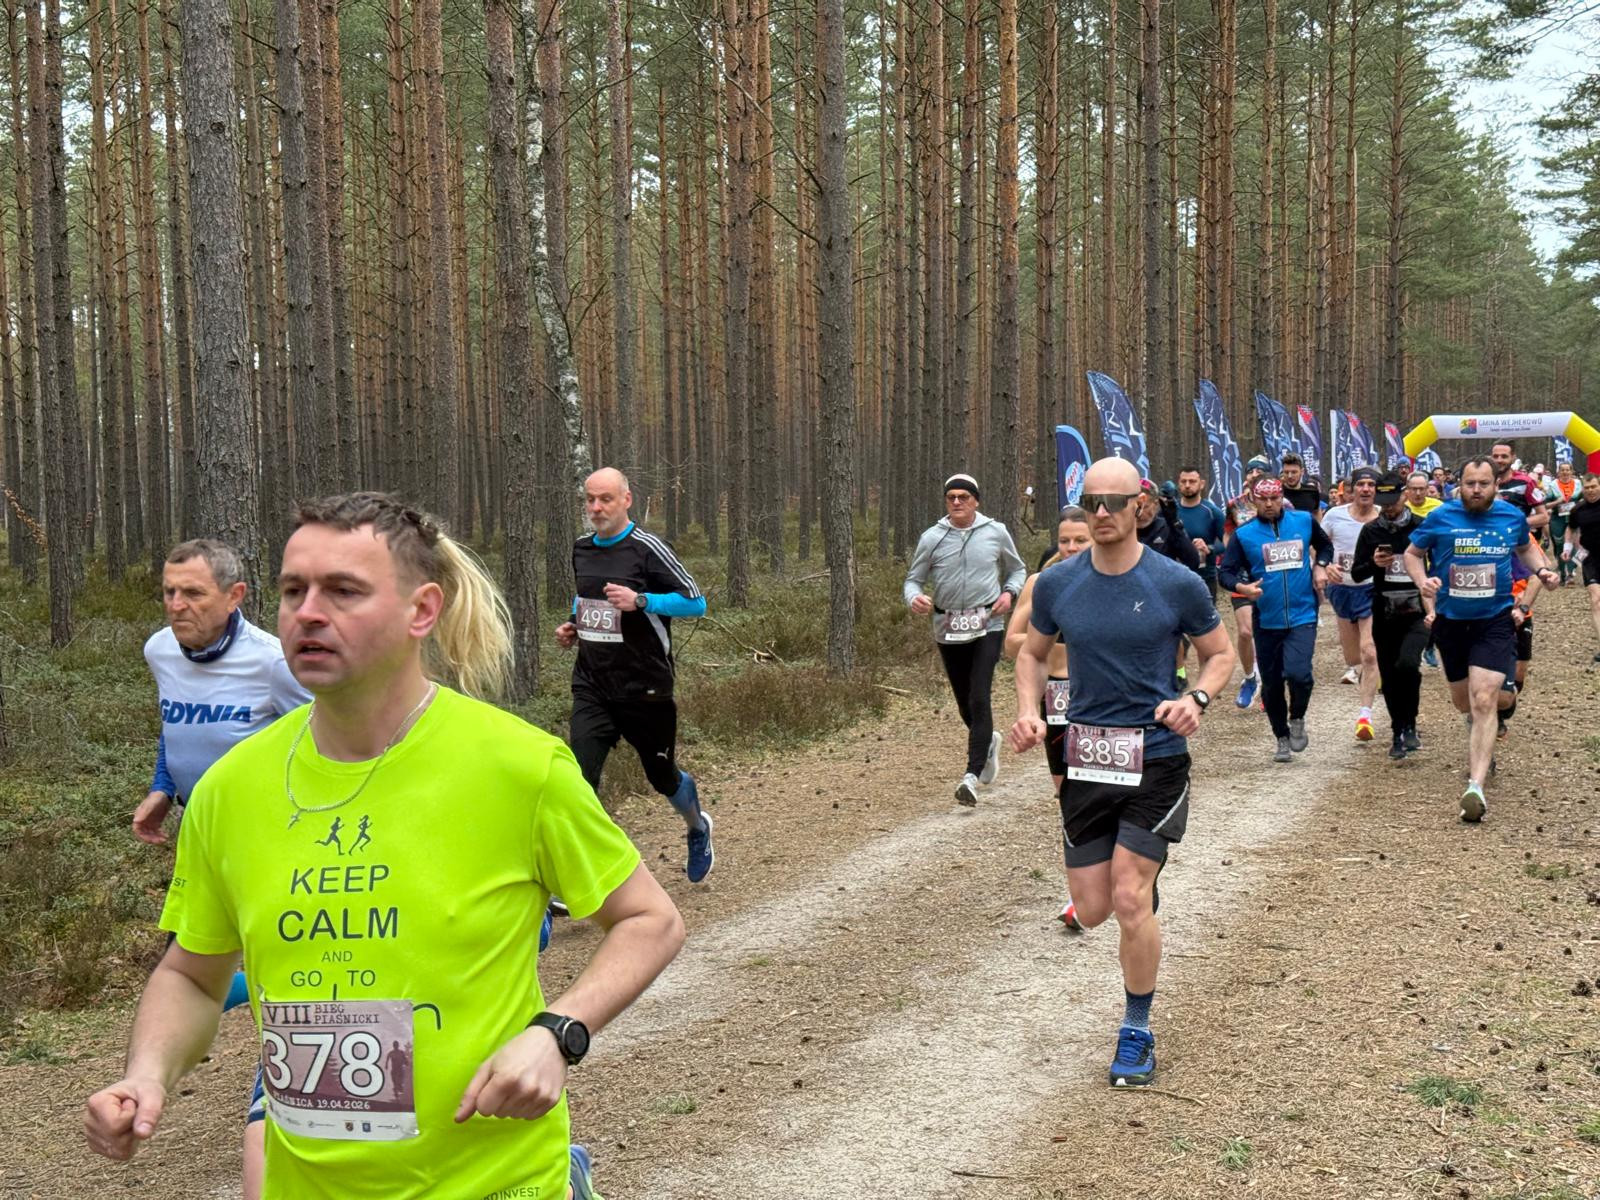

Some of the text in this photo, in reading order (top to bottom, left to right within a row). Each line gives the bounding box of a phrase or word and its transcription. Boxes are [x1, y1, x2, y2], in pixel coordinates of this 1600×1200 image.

[1454, 537, 1482, 547] BIEG
[1269, 546, 1299, 562] 546
[1454, 571, 1489, 588] 321
[581, 609, 613, 630] 495
[950, 615, 980, 631] 683
[160, 698, 251, 725] GDYNIA
[1078, 737, 1130, 767] 385
[290, 864, 390, 895] KEEP
[278, 906, 398, 942] CALM
[321, 950, 353, 963] AND
[290, 969, 376, 987] GO TO
[314, 1003, 345, 1014] BIEG
[314, 1012, 380, 1024] PIAŚNICKI
[262, 1028, 385, 1098] 378
[317, 1099, 371, 1110] 19.04.2026
